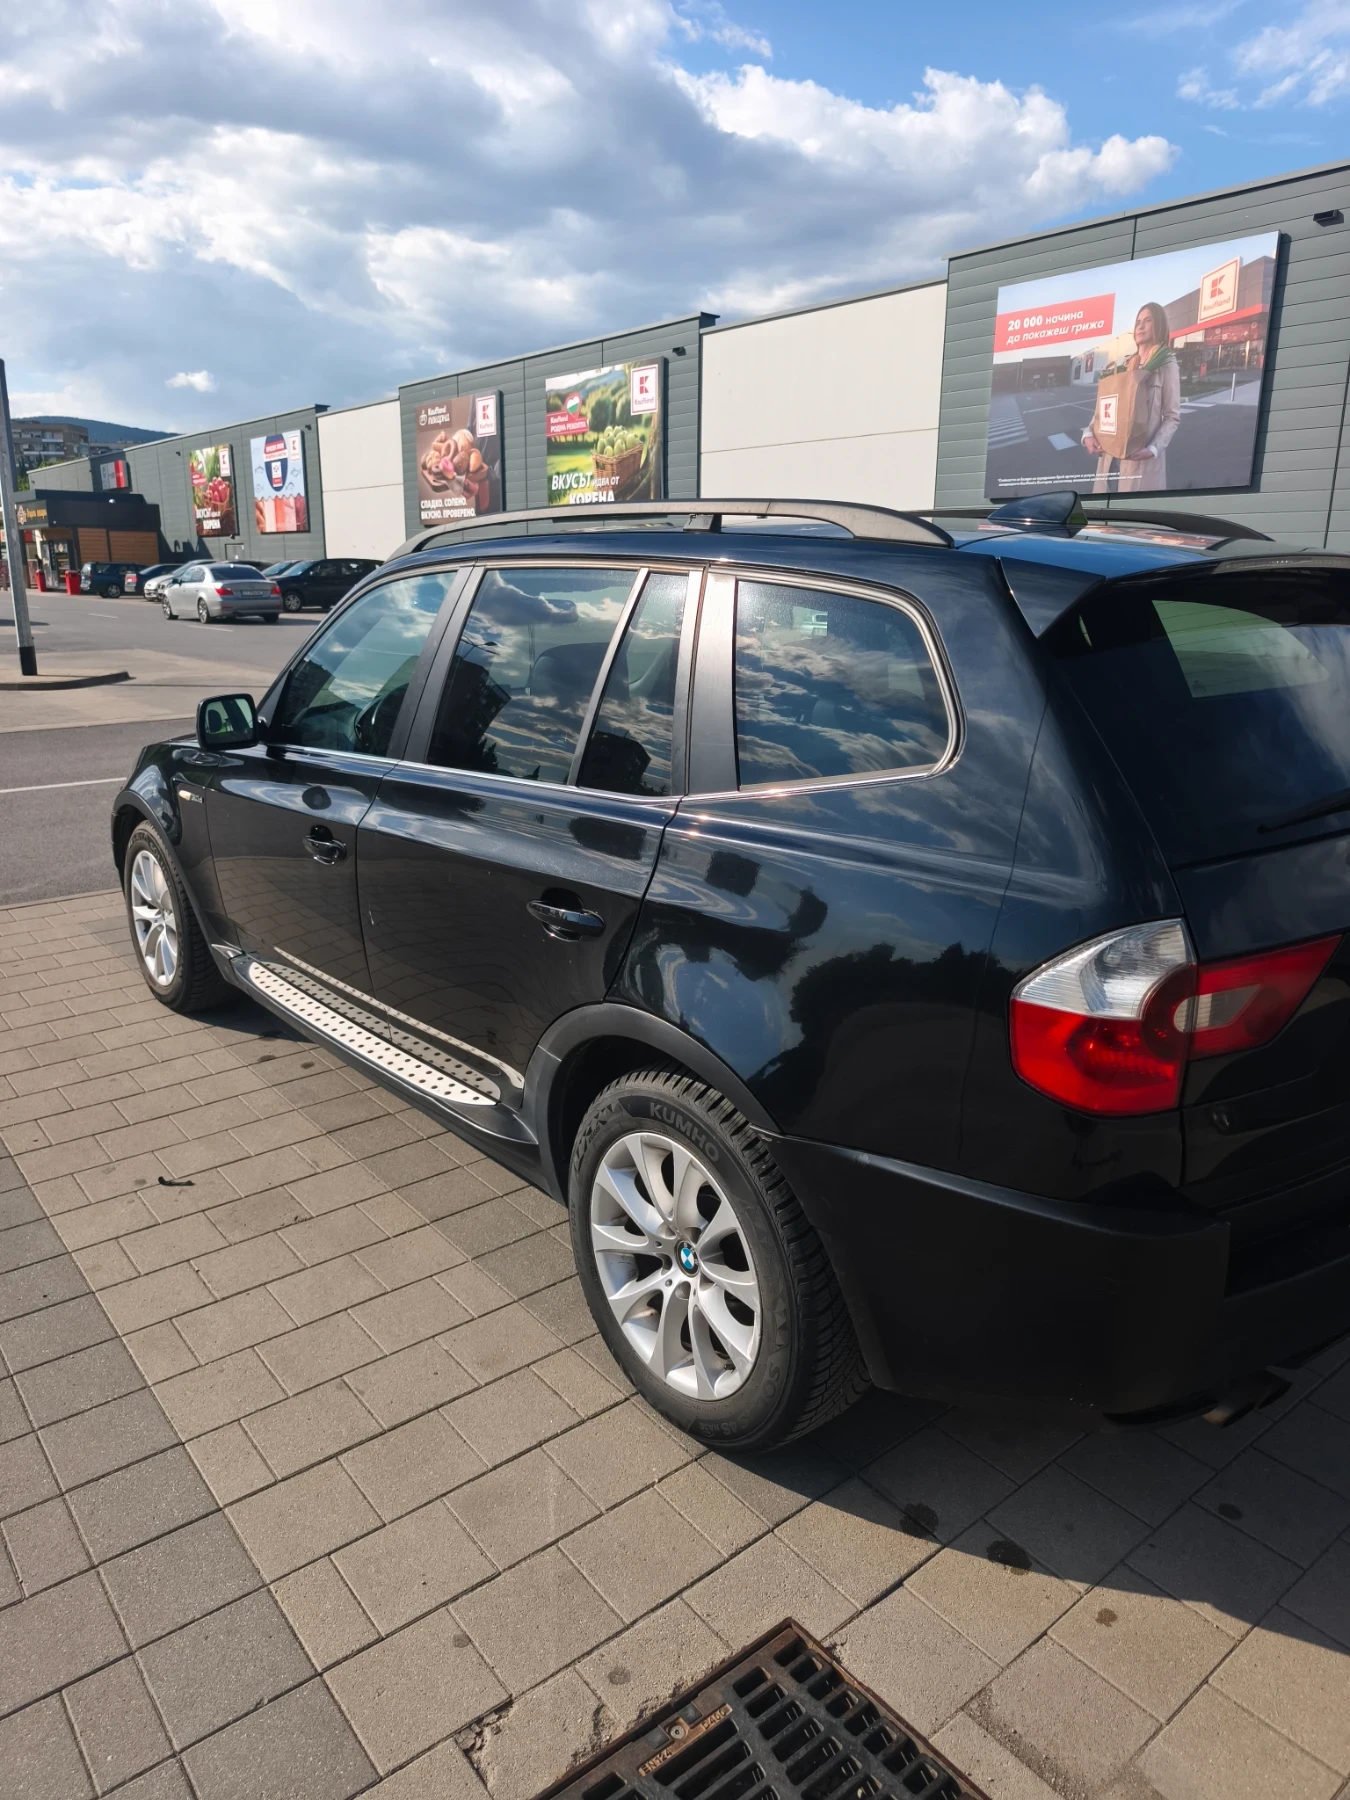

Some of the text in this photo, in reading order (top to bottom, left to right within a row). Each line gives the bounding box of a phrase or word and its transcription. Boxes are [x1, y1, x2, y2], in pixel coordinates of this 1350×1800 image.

[1203, 296, 1230, 311] Kaufland
[1007, 311, 1083, 331] 20 000 начина
[1006, 320, 1104, 346] да покажеш грижа
[552, 472, 592, 490] ВКУСЪТ
[610, 476, 620, 485] ОТ
[650, 1102, 719, 1161] KUMHO
[702, 1709, 726, 1730] D400
